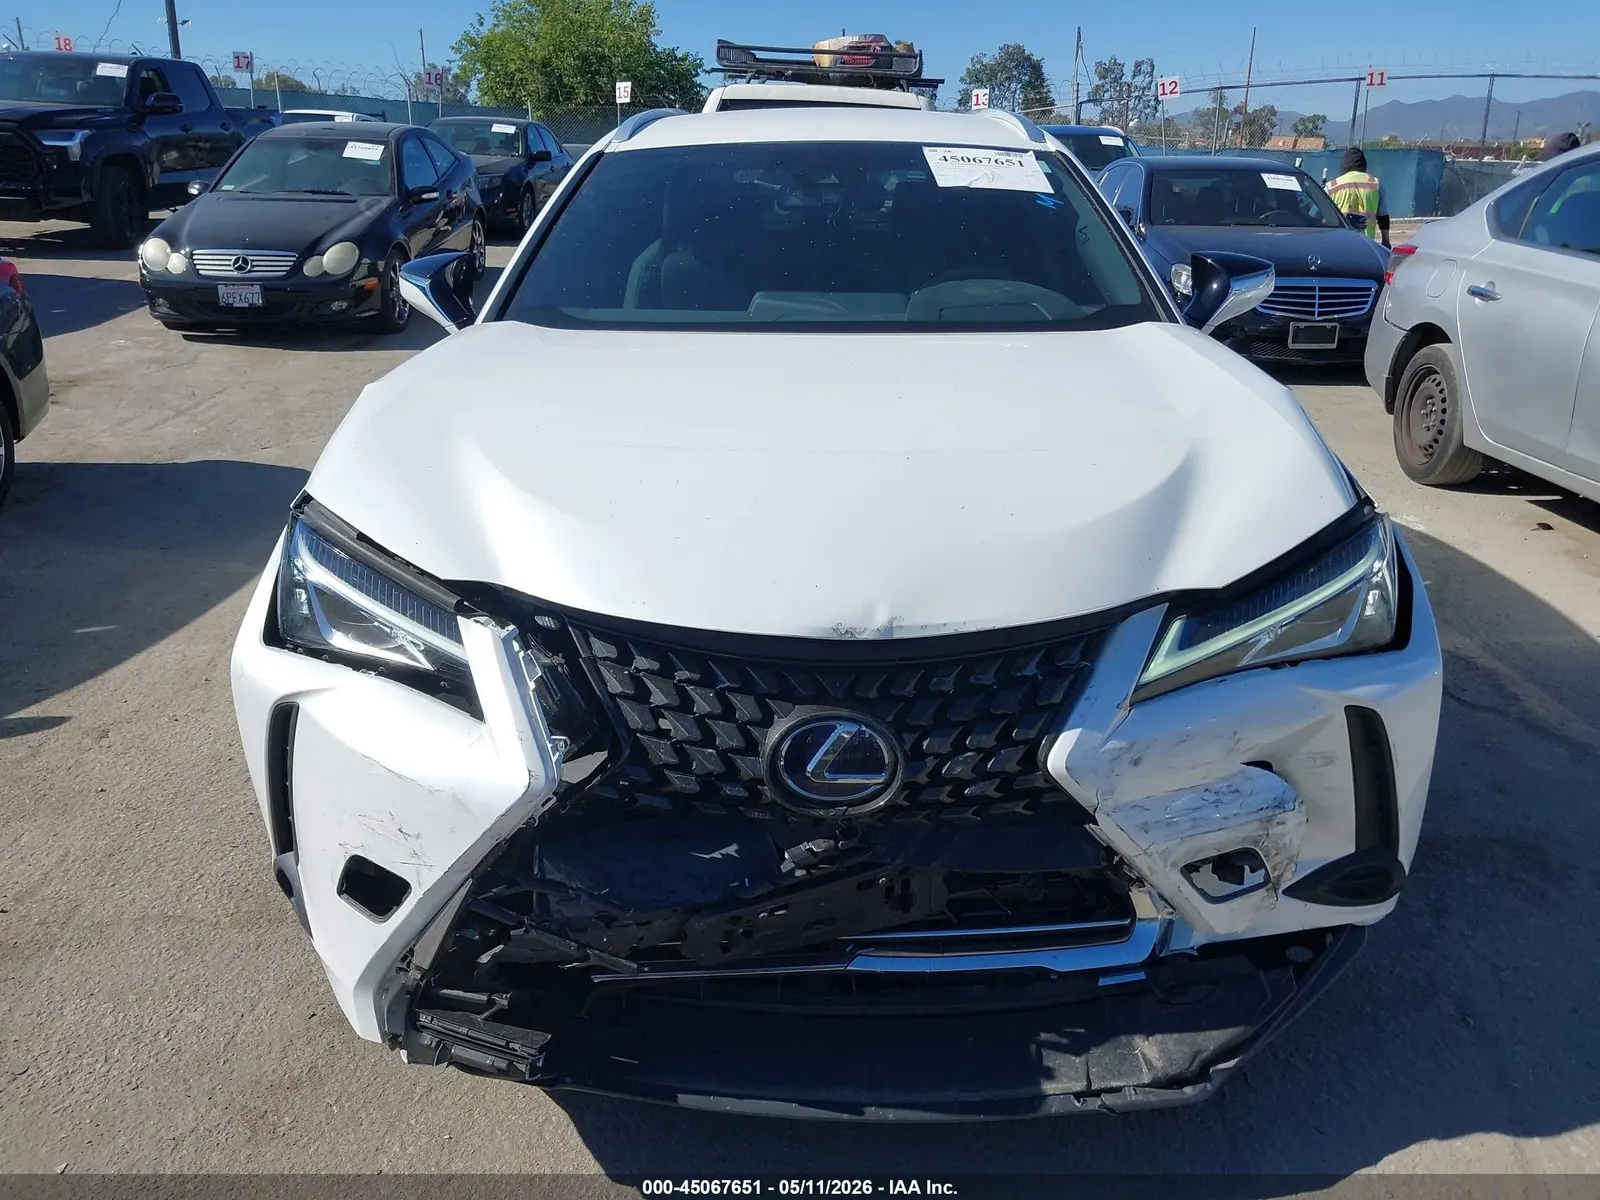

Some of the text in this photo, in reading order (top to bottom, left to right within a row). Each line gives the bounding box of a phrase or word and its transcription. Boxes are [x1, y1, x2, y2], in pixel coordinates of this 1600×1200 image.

[55, 37, 73, 52] 18
[234, 55, 250, 70] 17
[425, 72, 442, 86] 16
[1366, 71, 1386, 87] 11
[616, 85, 630, 99] 15
[1159, 80, 1179, 96] 12
[938, 154, 1025, 168] 45067651
